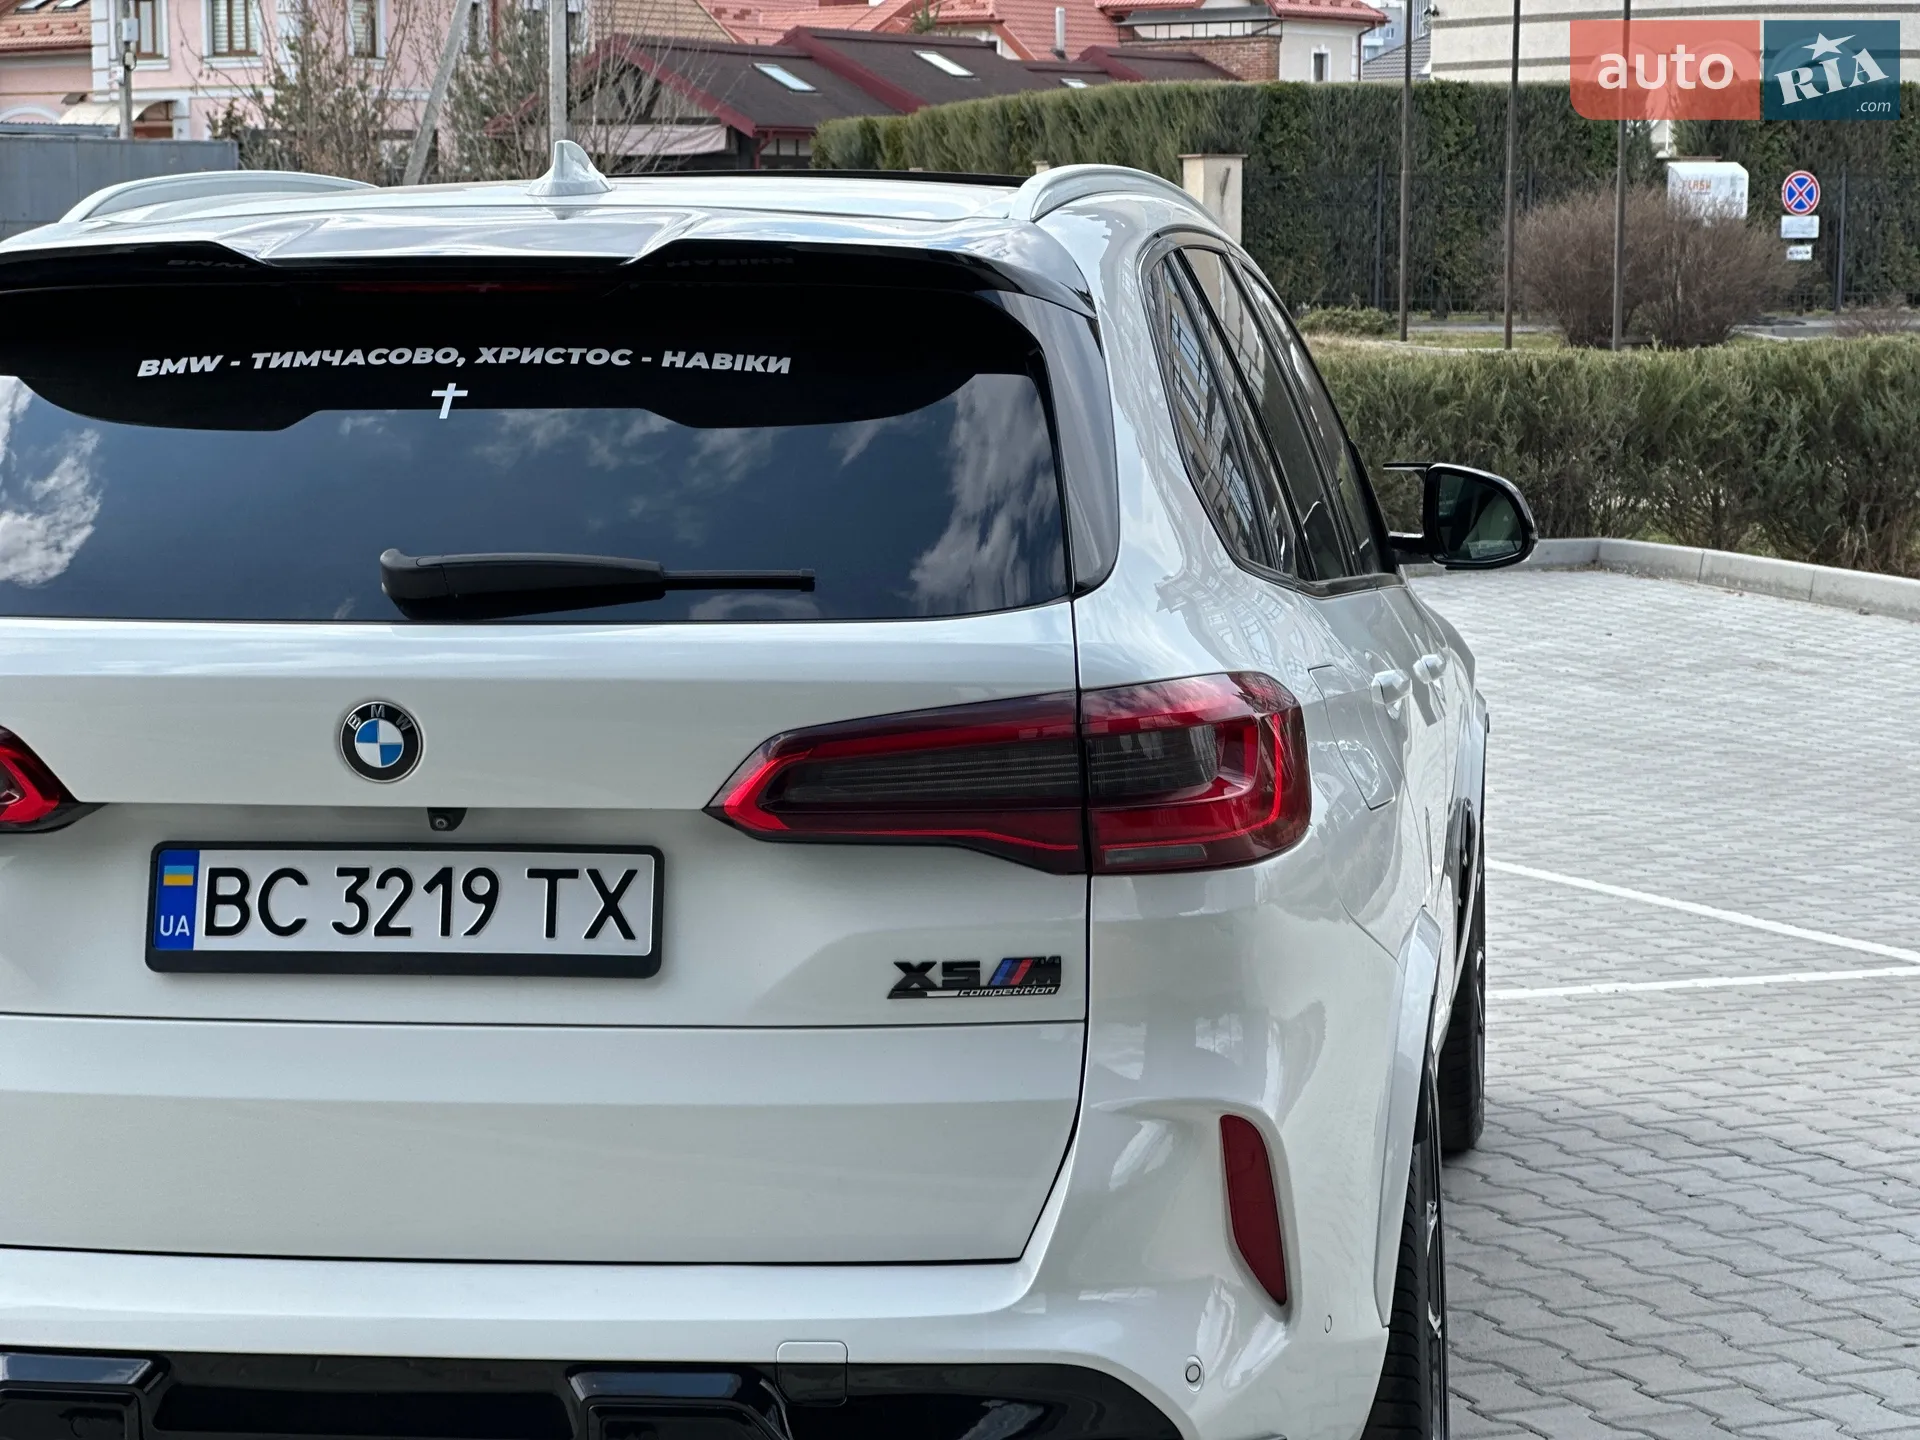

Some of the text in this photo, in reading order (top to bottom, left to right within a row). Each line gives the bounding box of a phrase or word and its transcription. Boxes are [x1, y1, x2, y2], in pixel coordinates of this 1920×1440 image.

[137, 355, 223, 377] BMW
[251, 348, 466, 370] ТИМЧАСОВО,
[474, 347, 632, 366] ХРИСТОС
[661, 350, 791, 374] НАВІКИ
[347, 704, 413, 731] BMW
[204, 866, 639, 941] BC 3219 TX
[159, 914, 191, 937] UA
[959, 986, 1056, 997] competition
